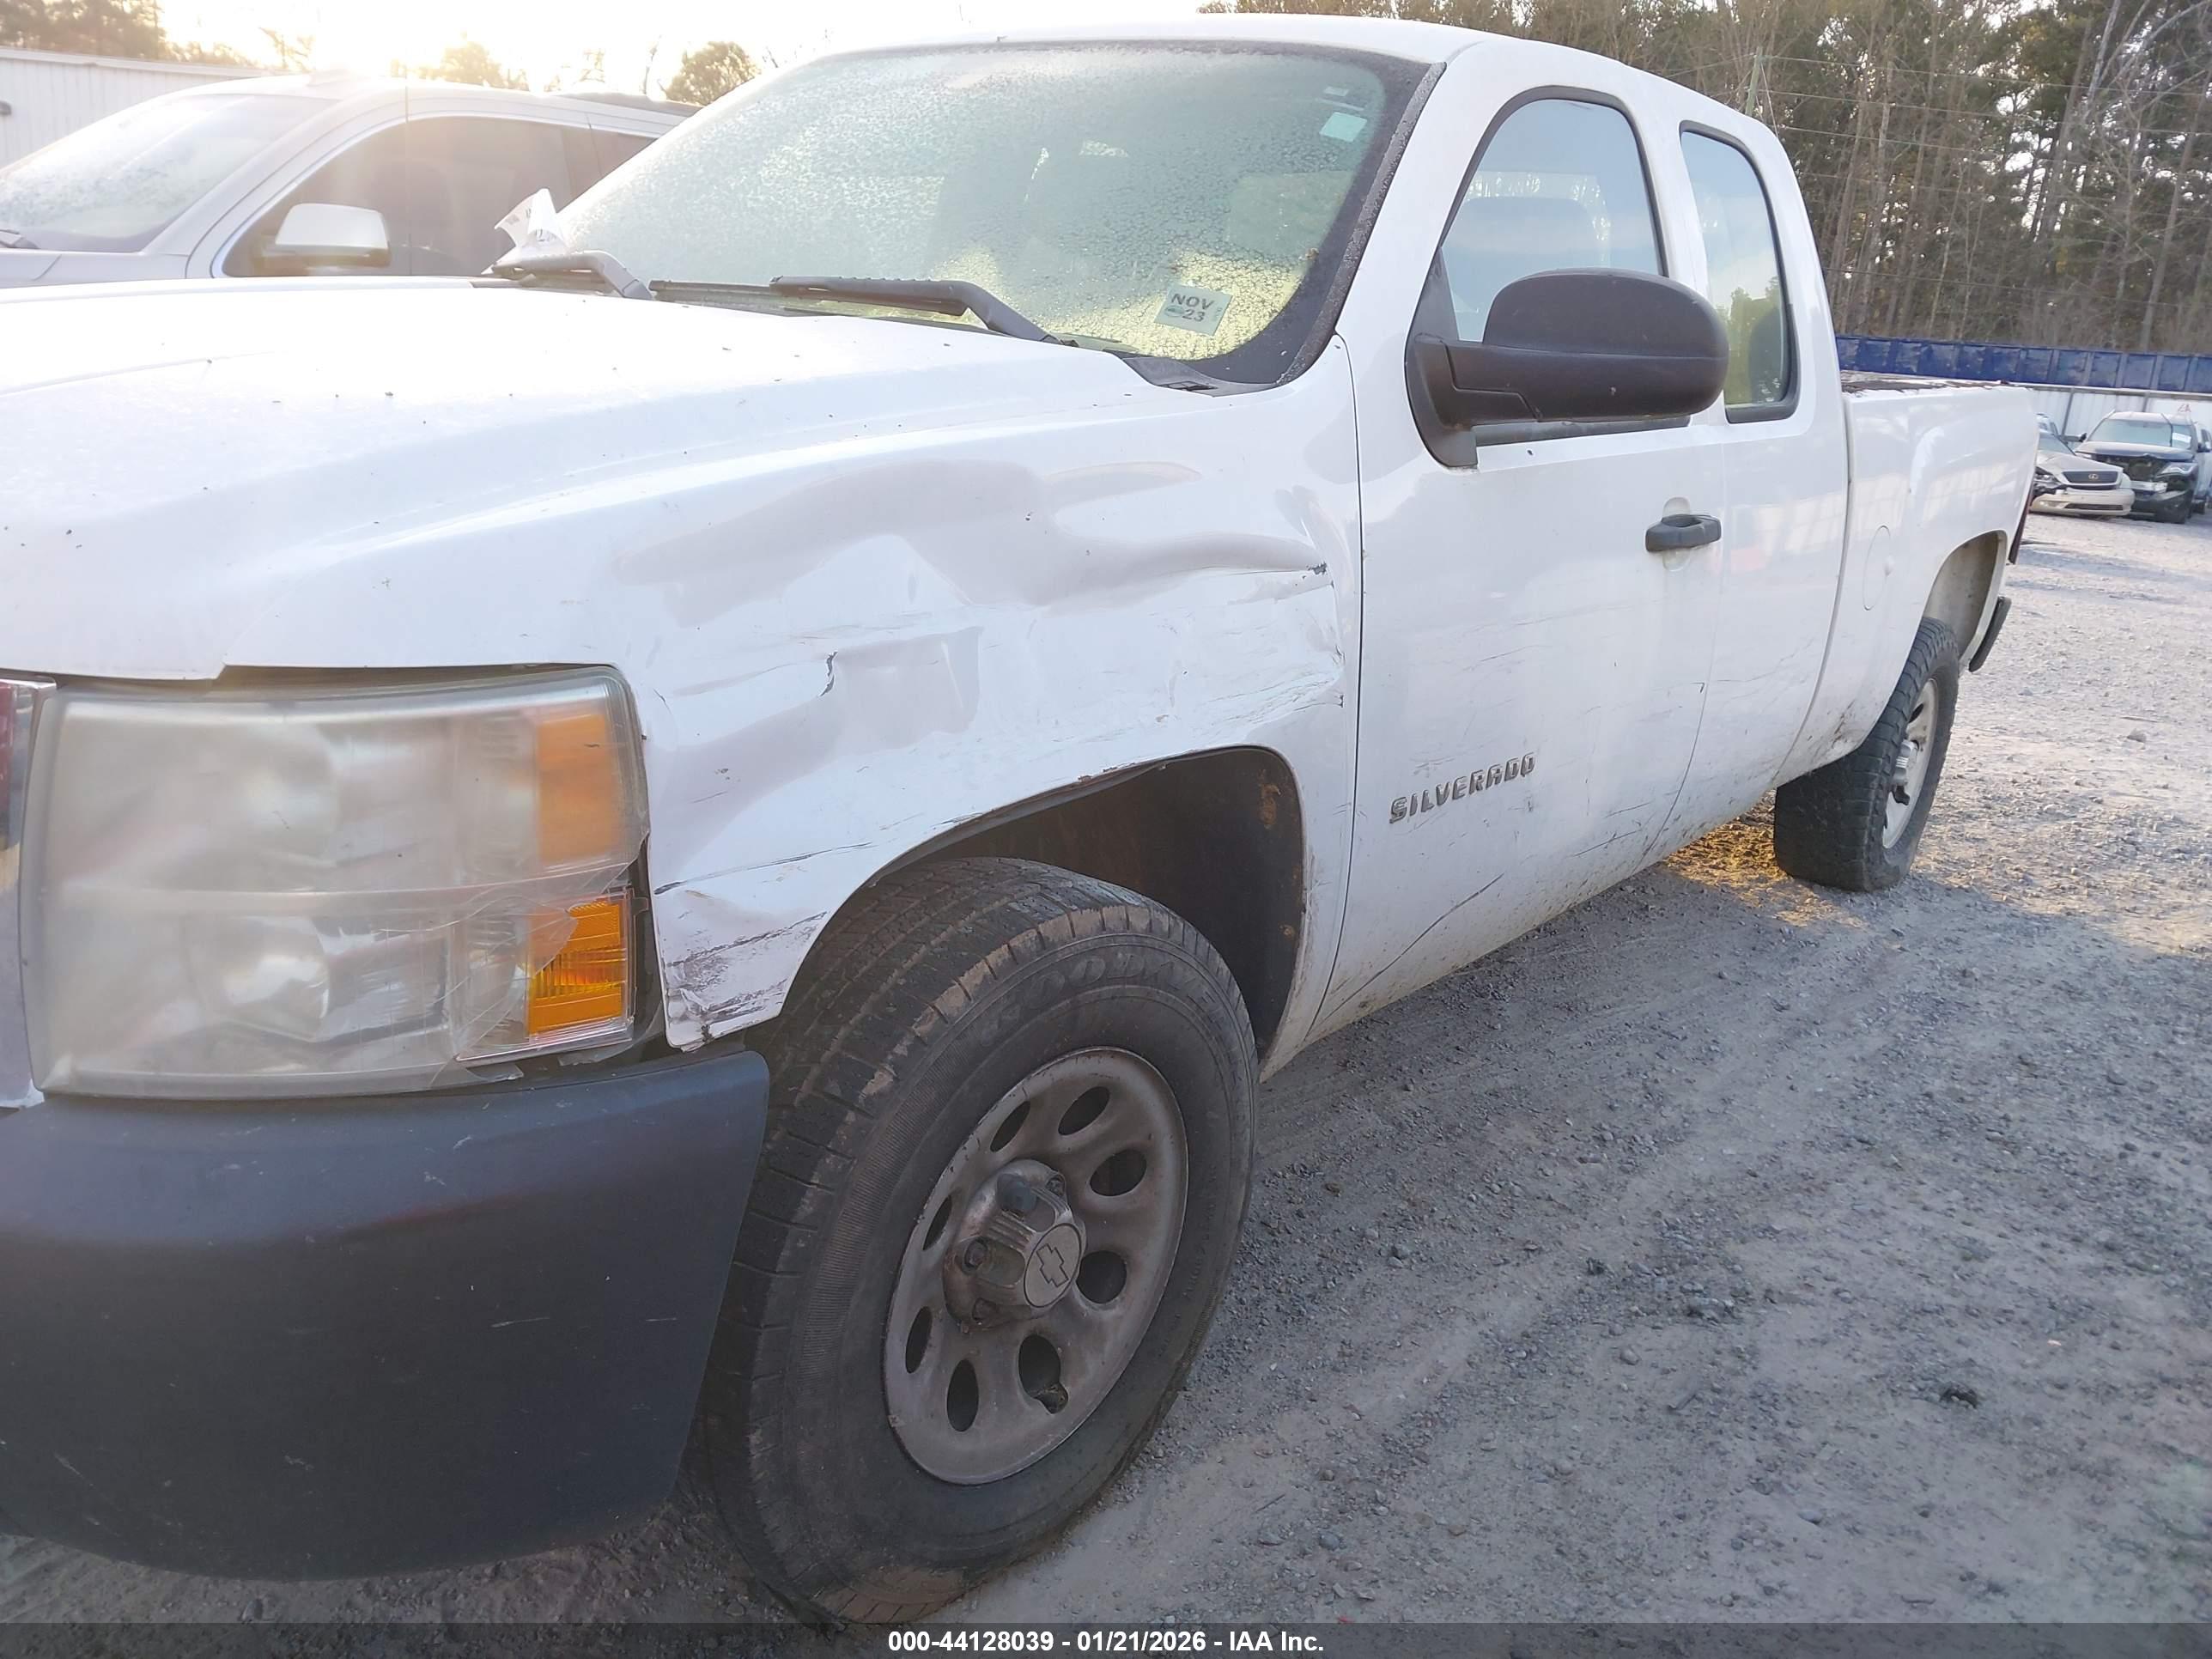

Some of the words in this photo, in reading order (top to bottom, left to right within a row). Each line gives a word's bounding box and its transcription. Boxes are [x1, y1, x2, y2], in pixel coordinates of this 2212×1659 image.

[1170, 293, 1215, 310] NOV
[1182, 308, 1206, 322] 23
[1389, 751, 1537, 824] SILVERADO
